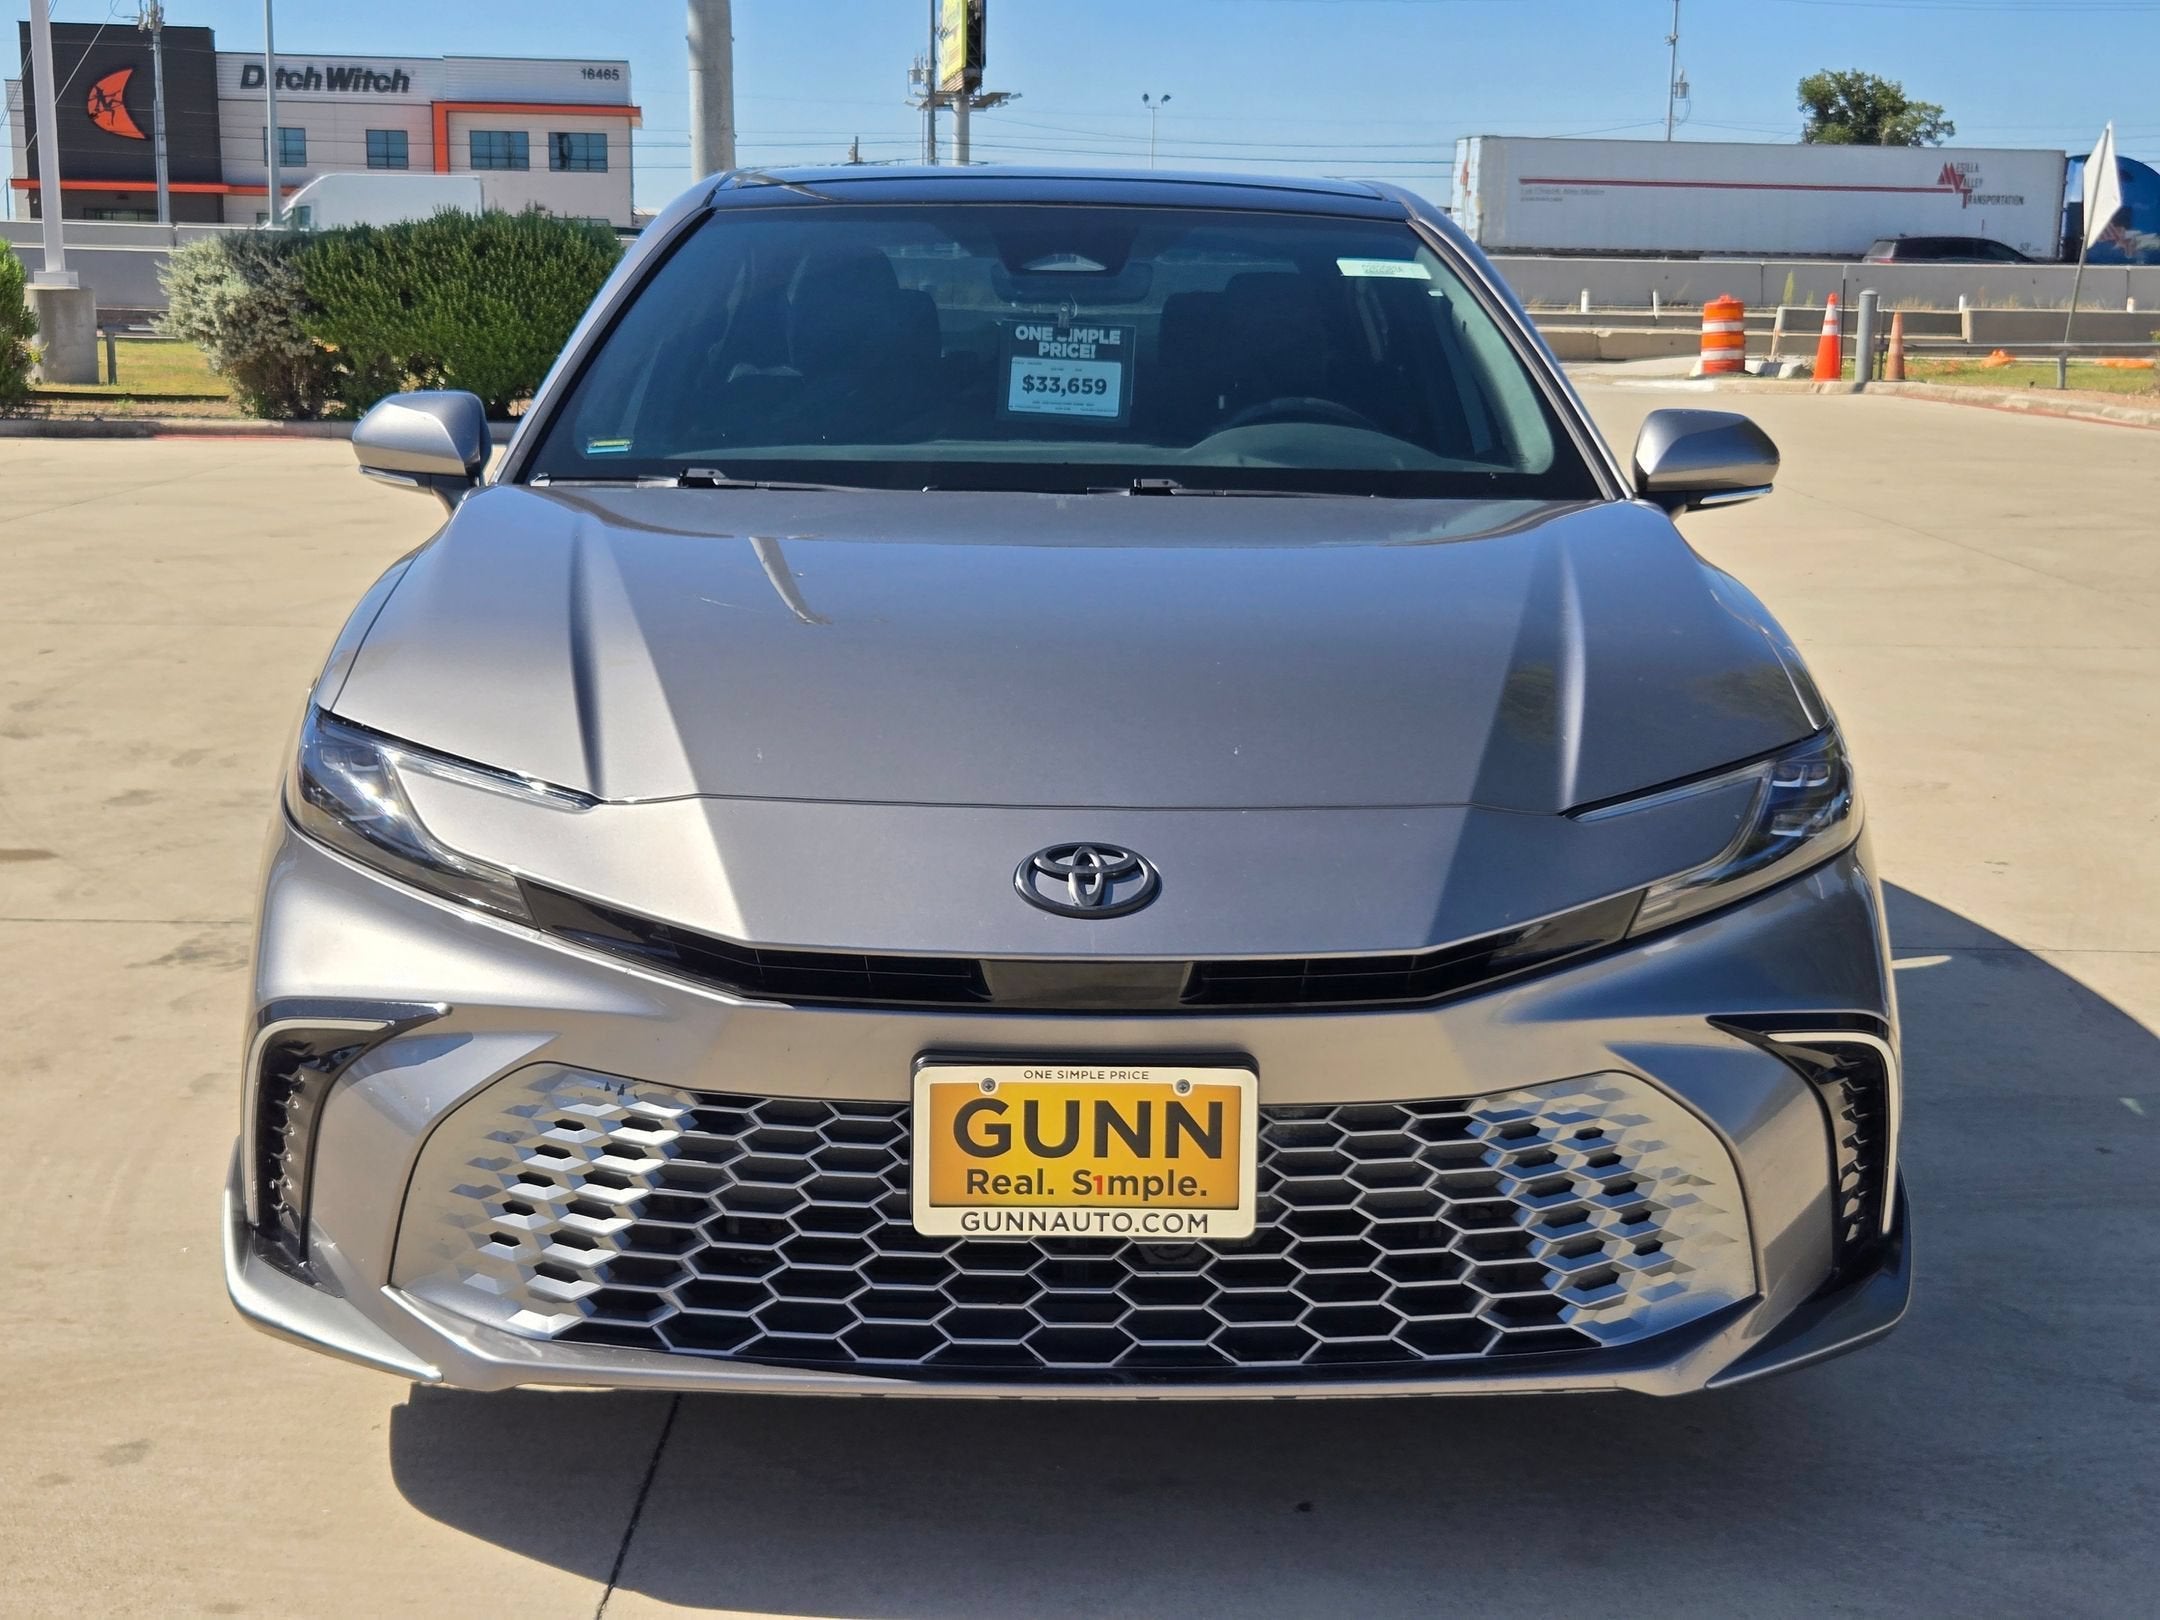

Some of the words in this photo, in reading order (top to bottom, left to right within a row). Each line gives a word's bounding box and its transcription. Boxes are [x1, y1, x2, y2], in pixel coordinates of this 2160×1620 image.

[239, 64, 323, 91] Dtch
[325, 66, 411, 93] Witch
[581, 68, 620, 81] 16465
[1015, 325, 1054, 341] ONE
[1038, 342, 1097, 359] PRICE!
[1022, 374, 1108, 397] $33,659
[1023, 1069, 1052, 1080] ONE
[1056, 1070, 1105, 1080] SIMPLE
[1109, 1070, 1149, 1080] PRICE
[953, 1097, 1223, 1159] GUNN
[966, 1168, 1054, 1195] Real.
[961, 1211, 1208, 1233] GUNNAUTO.COM
